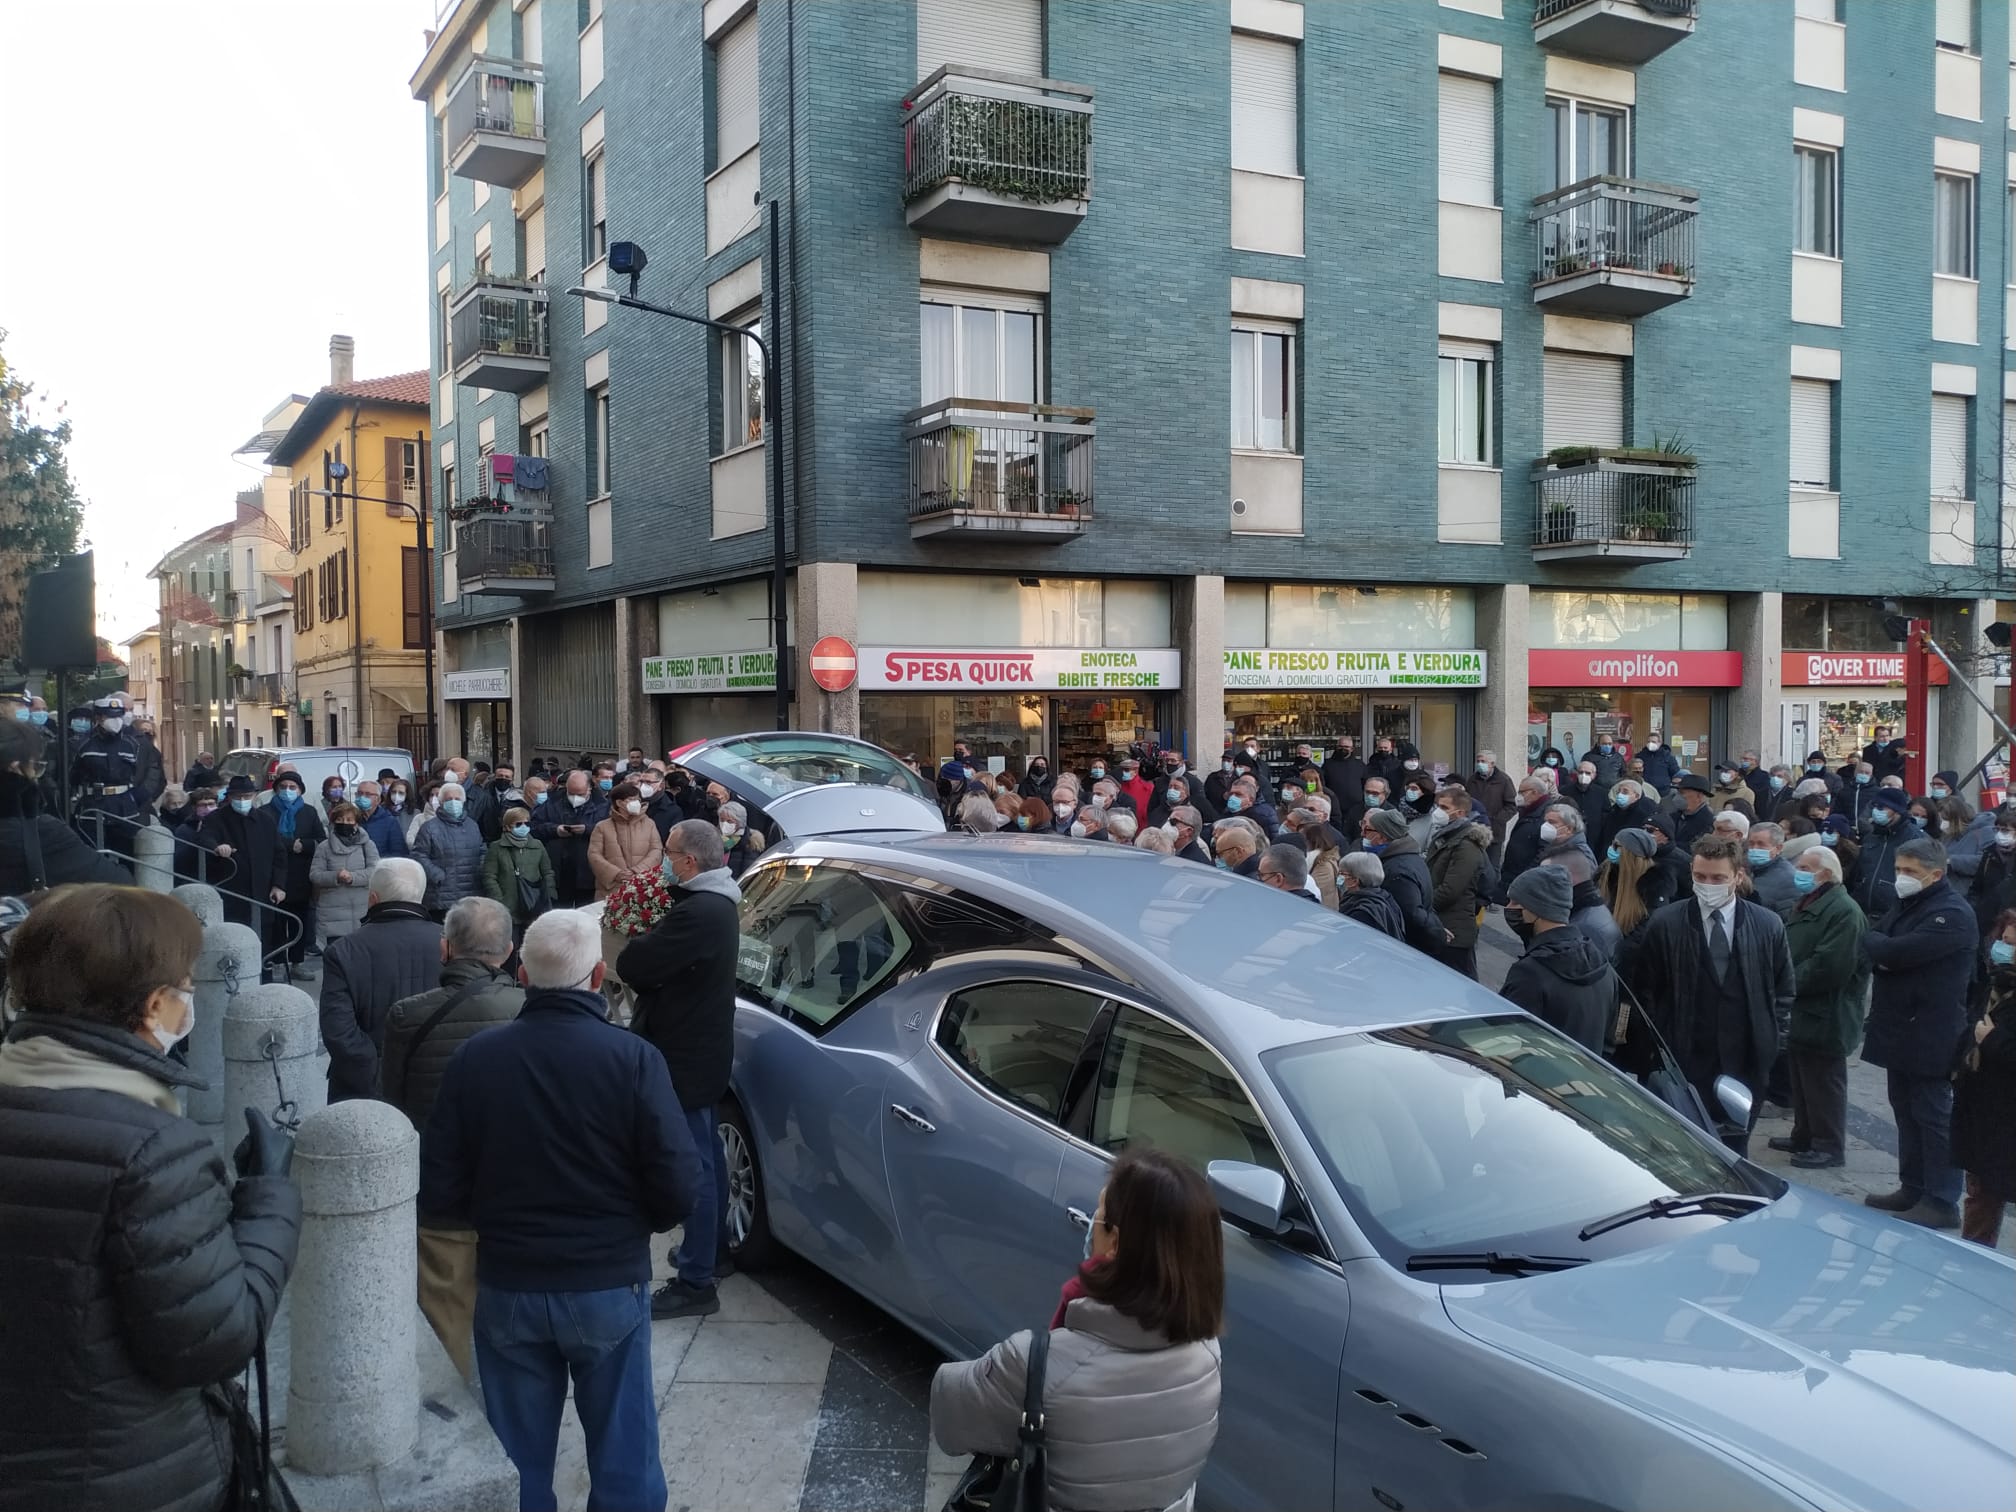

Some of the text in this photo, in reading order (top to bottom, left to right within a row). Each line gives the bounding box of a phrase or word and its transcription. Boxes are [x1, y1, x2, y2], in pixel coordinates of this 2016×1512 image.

[645, 661, 663, 678] PANE
[666, 659, 694, 677] FRESCO
[698, 656, 725, 675] FRUTTA
[728, 656, 734, 674] E
[885, 652, 1034, 685] SPESA QUICK
[1080, 652, 1137, 667] ENOTECA
[1224, 652, 1481, 671] PANE FRESCO FRUTTA E VERDURA
[1588, 654, 1678, 683] amplifon
[1808, 655, 1905, 677] COVER TIME
[1058, 673, 1160, 687] BIBITE FRESCHE
[1277, 674, 1284, 685] A
[1286, 674, 1333, 685] DOMICILIO
[1336, 674, 1379, 685] GRATUITA
